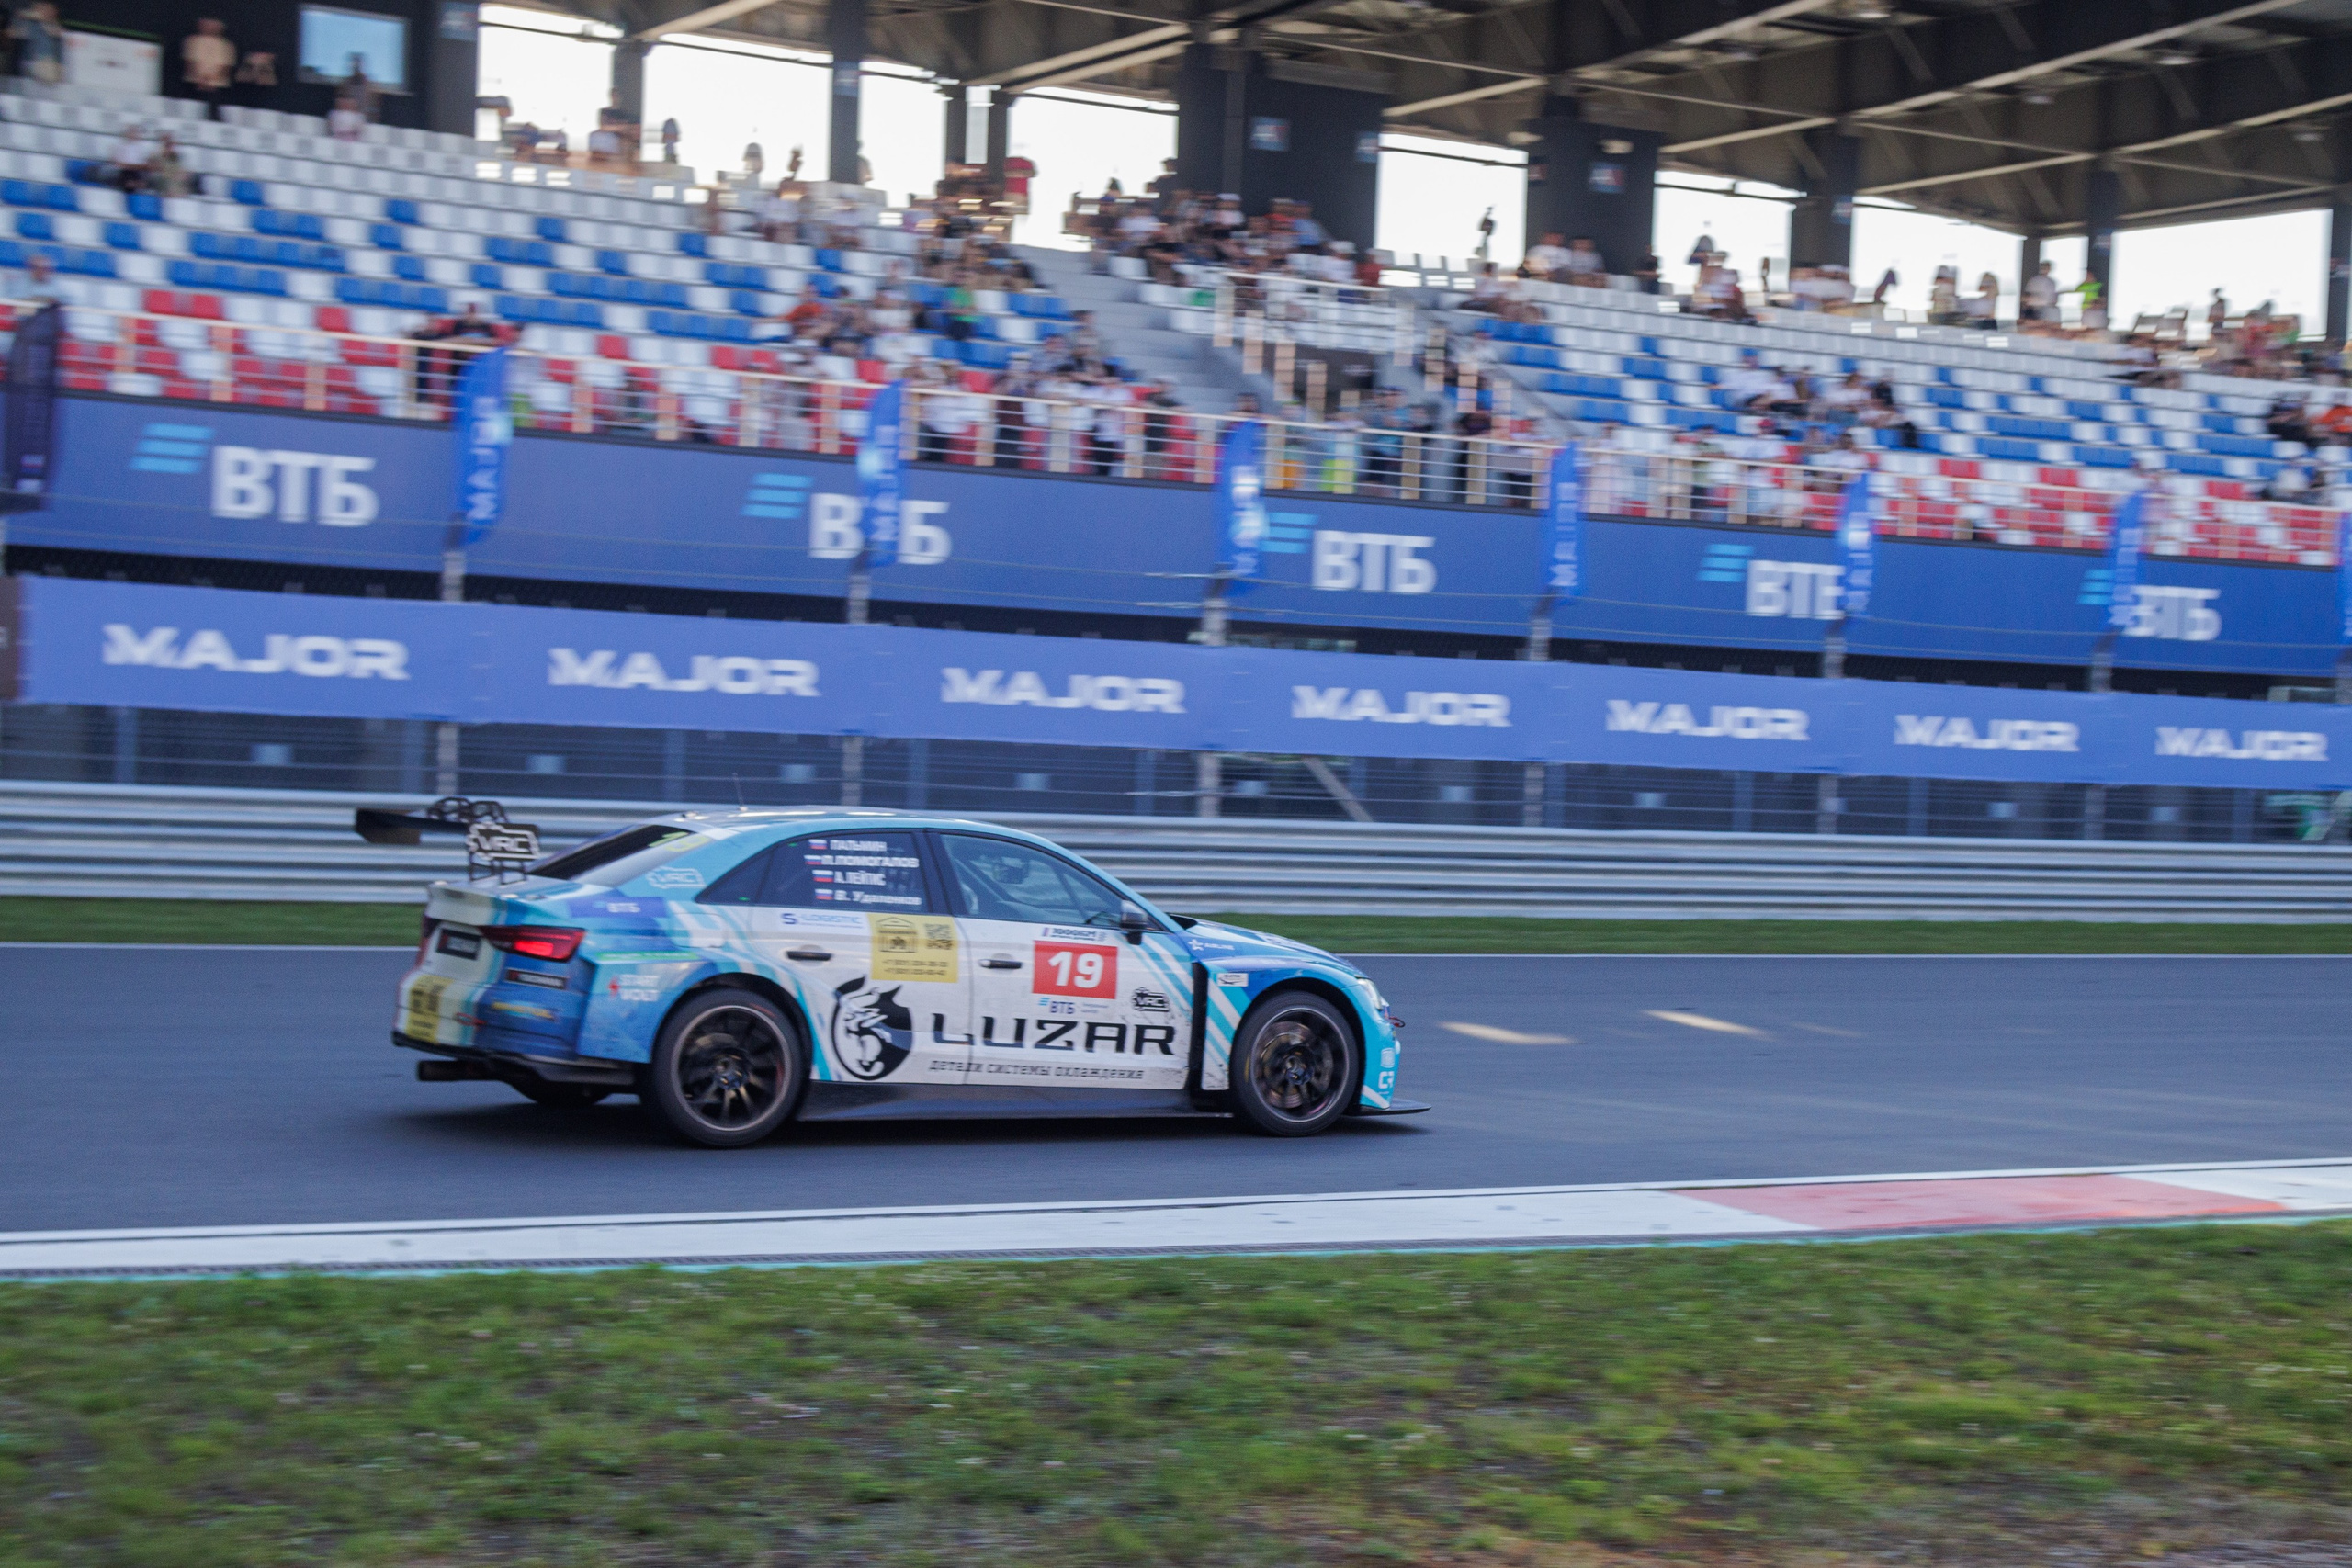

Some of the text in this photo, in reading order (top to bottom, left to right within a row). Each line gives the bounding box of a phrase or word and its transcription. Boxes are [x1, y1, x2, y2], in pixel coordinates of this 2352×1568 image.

[211, 445, 379, 527] ВТБ
[808, 491, 952, 566] ВБ
[1312, 529, 1437, 595] ВТБ
[103, 623, 410, 681] MAJOR
[548, 647, 821, 697] MAJOR
[940, 666, 1187, 714] MAJOR
[1291, 684, 1510, 728] MAJOR
[1606, 699, 1810, 740] MAJOR
[1894, 714, 2080, 752] MAJOR
[2155, 726, 2329, 761] MAJOR
[1047, 951, 1104, 988] 19
[932, 1012, 1176, 1056] LUZAR
